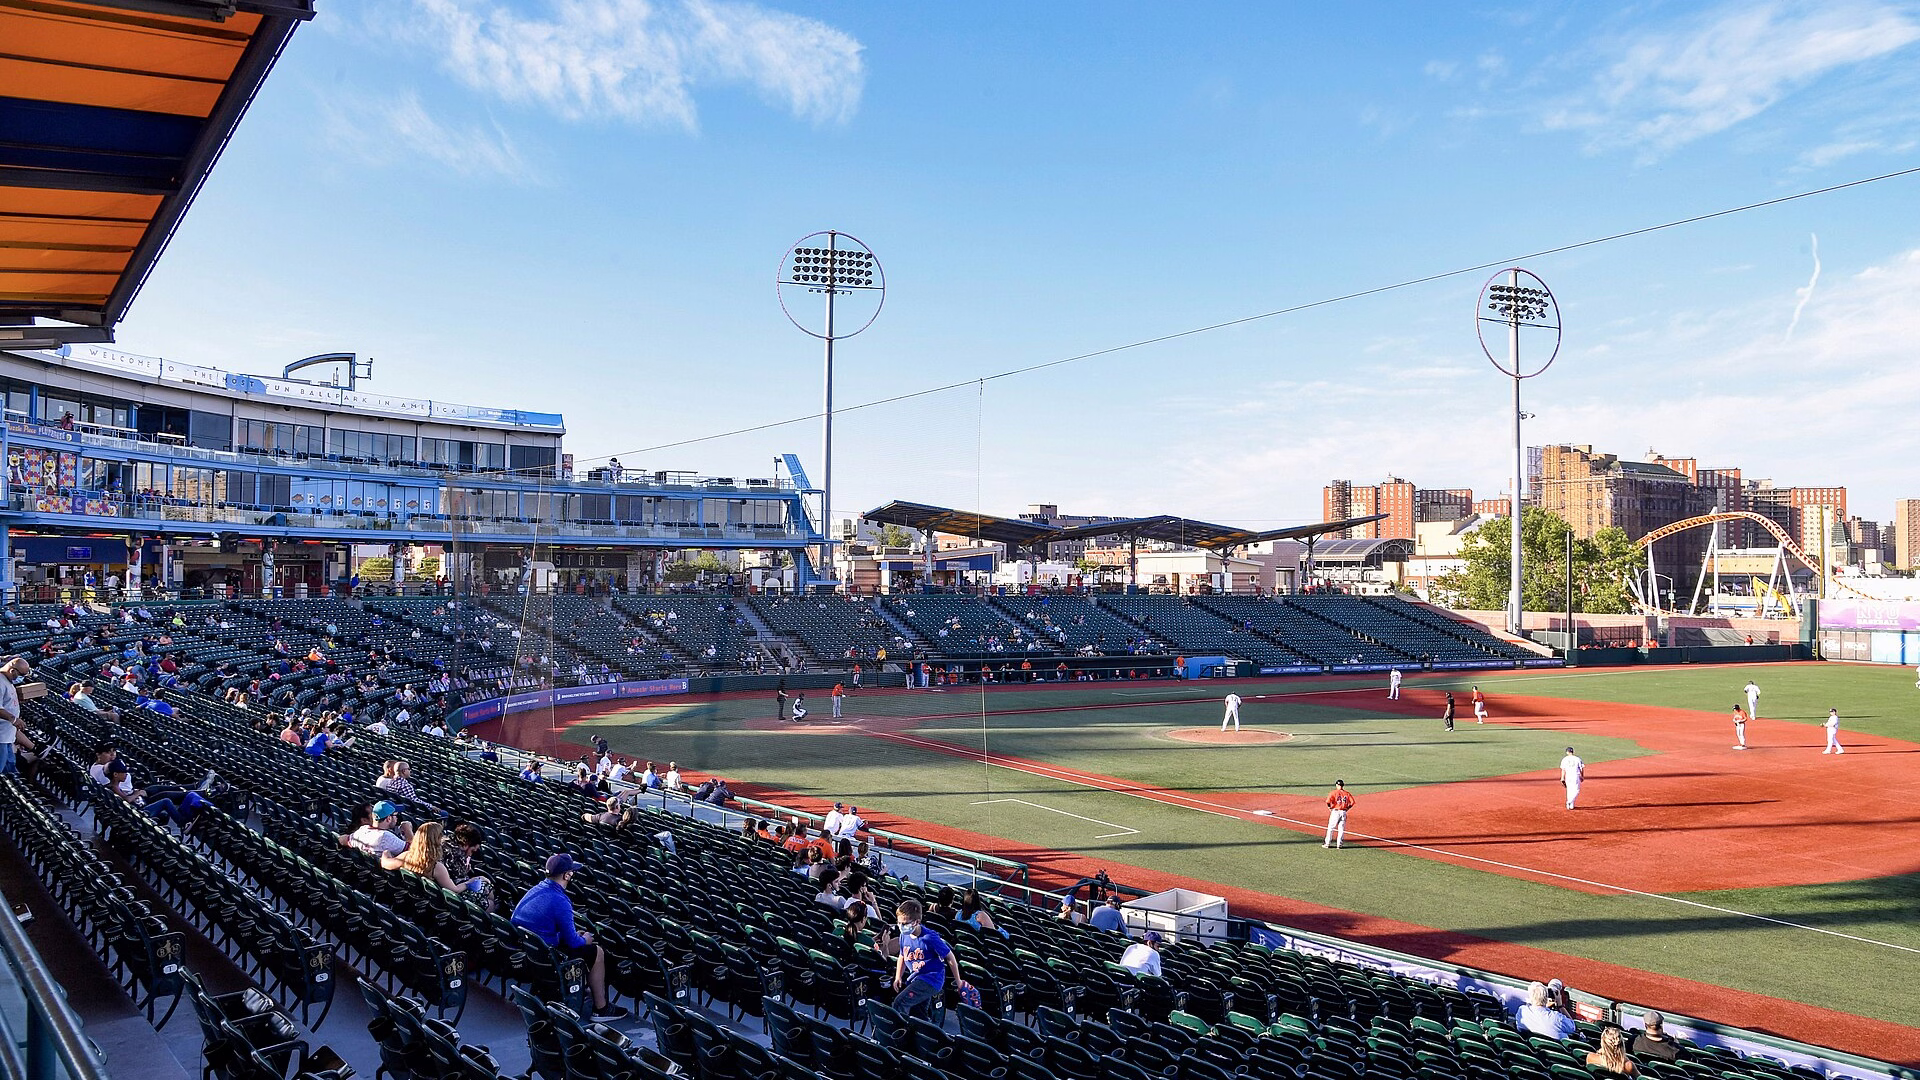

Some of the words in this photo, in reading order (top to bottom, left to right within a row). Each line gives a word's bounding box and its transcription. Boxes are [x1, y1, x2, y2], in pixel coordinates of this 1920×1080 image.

[89, 348, 150, 368] WELCOME
[193, 370, 213, 381] THE
[265, 383, 290, 392] FUN
[300, 388, 368, 403] BALLPARK
[401, 402, 456, 414] AMEICA
[556, 553, 605, 566] STORE
[1856, 604, 1899, 619] NYU
